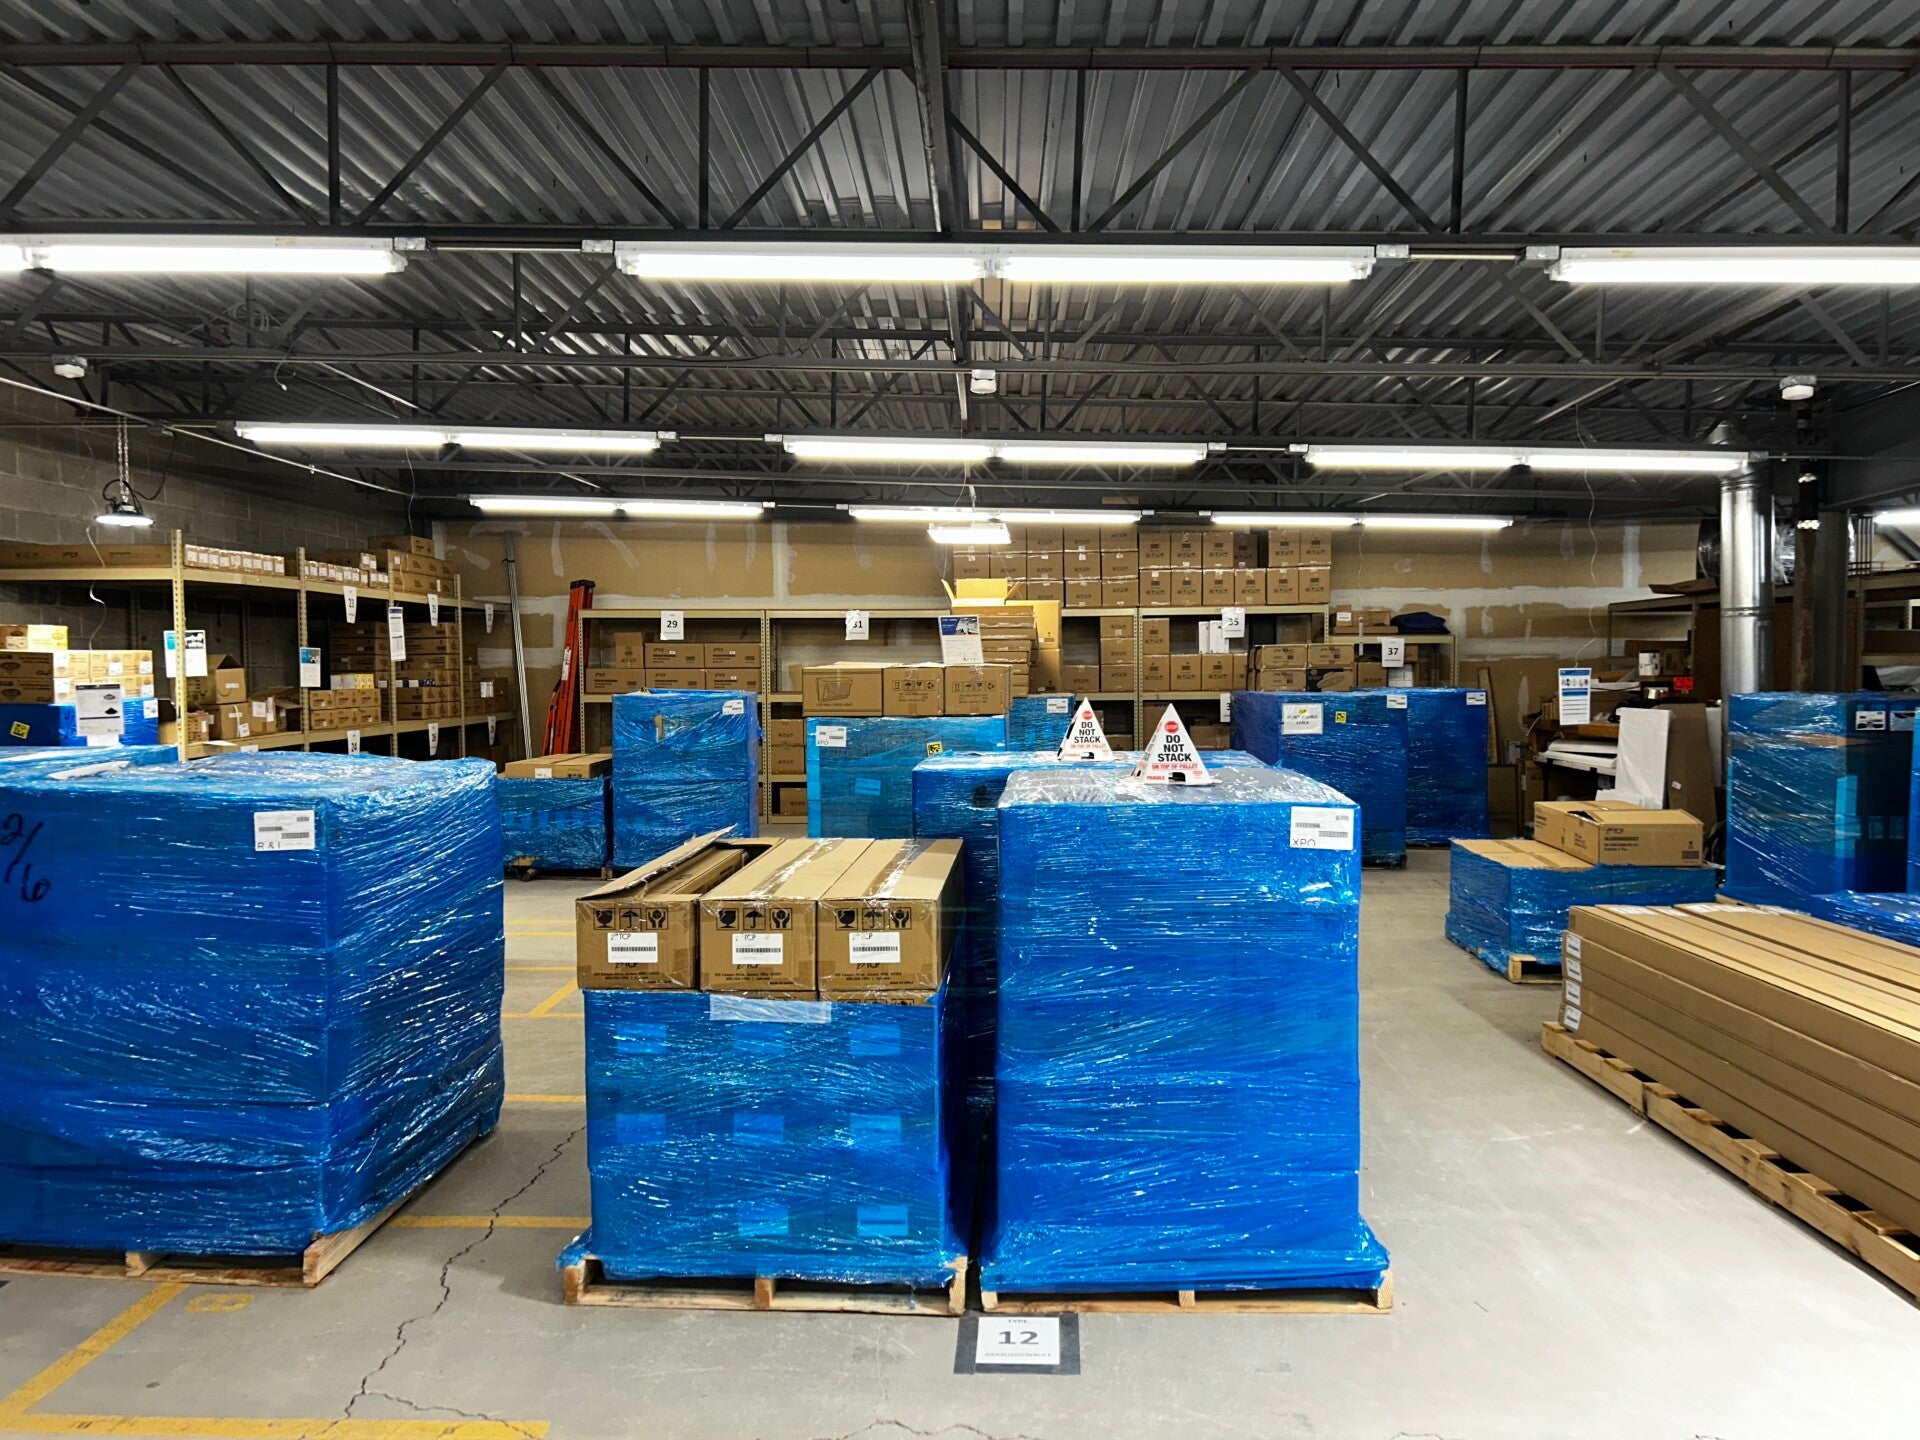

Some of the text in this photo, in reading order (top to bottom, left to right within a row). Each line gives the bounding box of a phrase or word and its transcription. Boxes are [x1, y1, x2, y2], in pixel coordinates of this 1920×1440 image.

[666, 620, 678, 628] 29
[852, 620, 864, 629] 31
[1387, 647, 1399, 656] 37
[1166, 734, 1181, 744] DO
[1163, 744, 1184, 753] NOT
[1157, 753, 1192, 762] STACK
[998, 1330, 1040, 1345] 12
